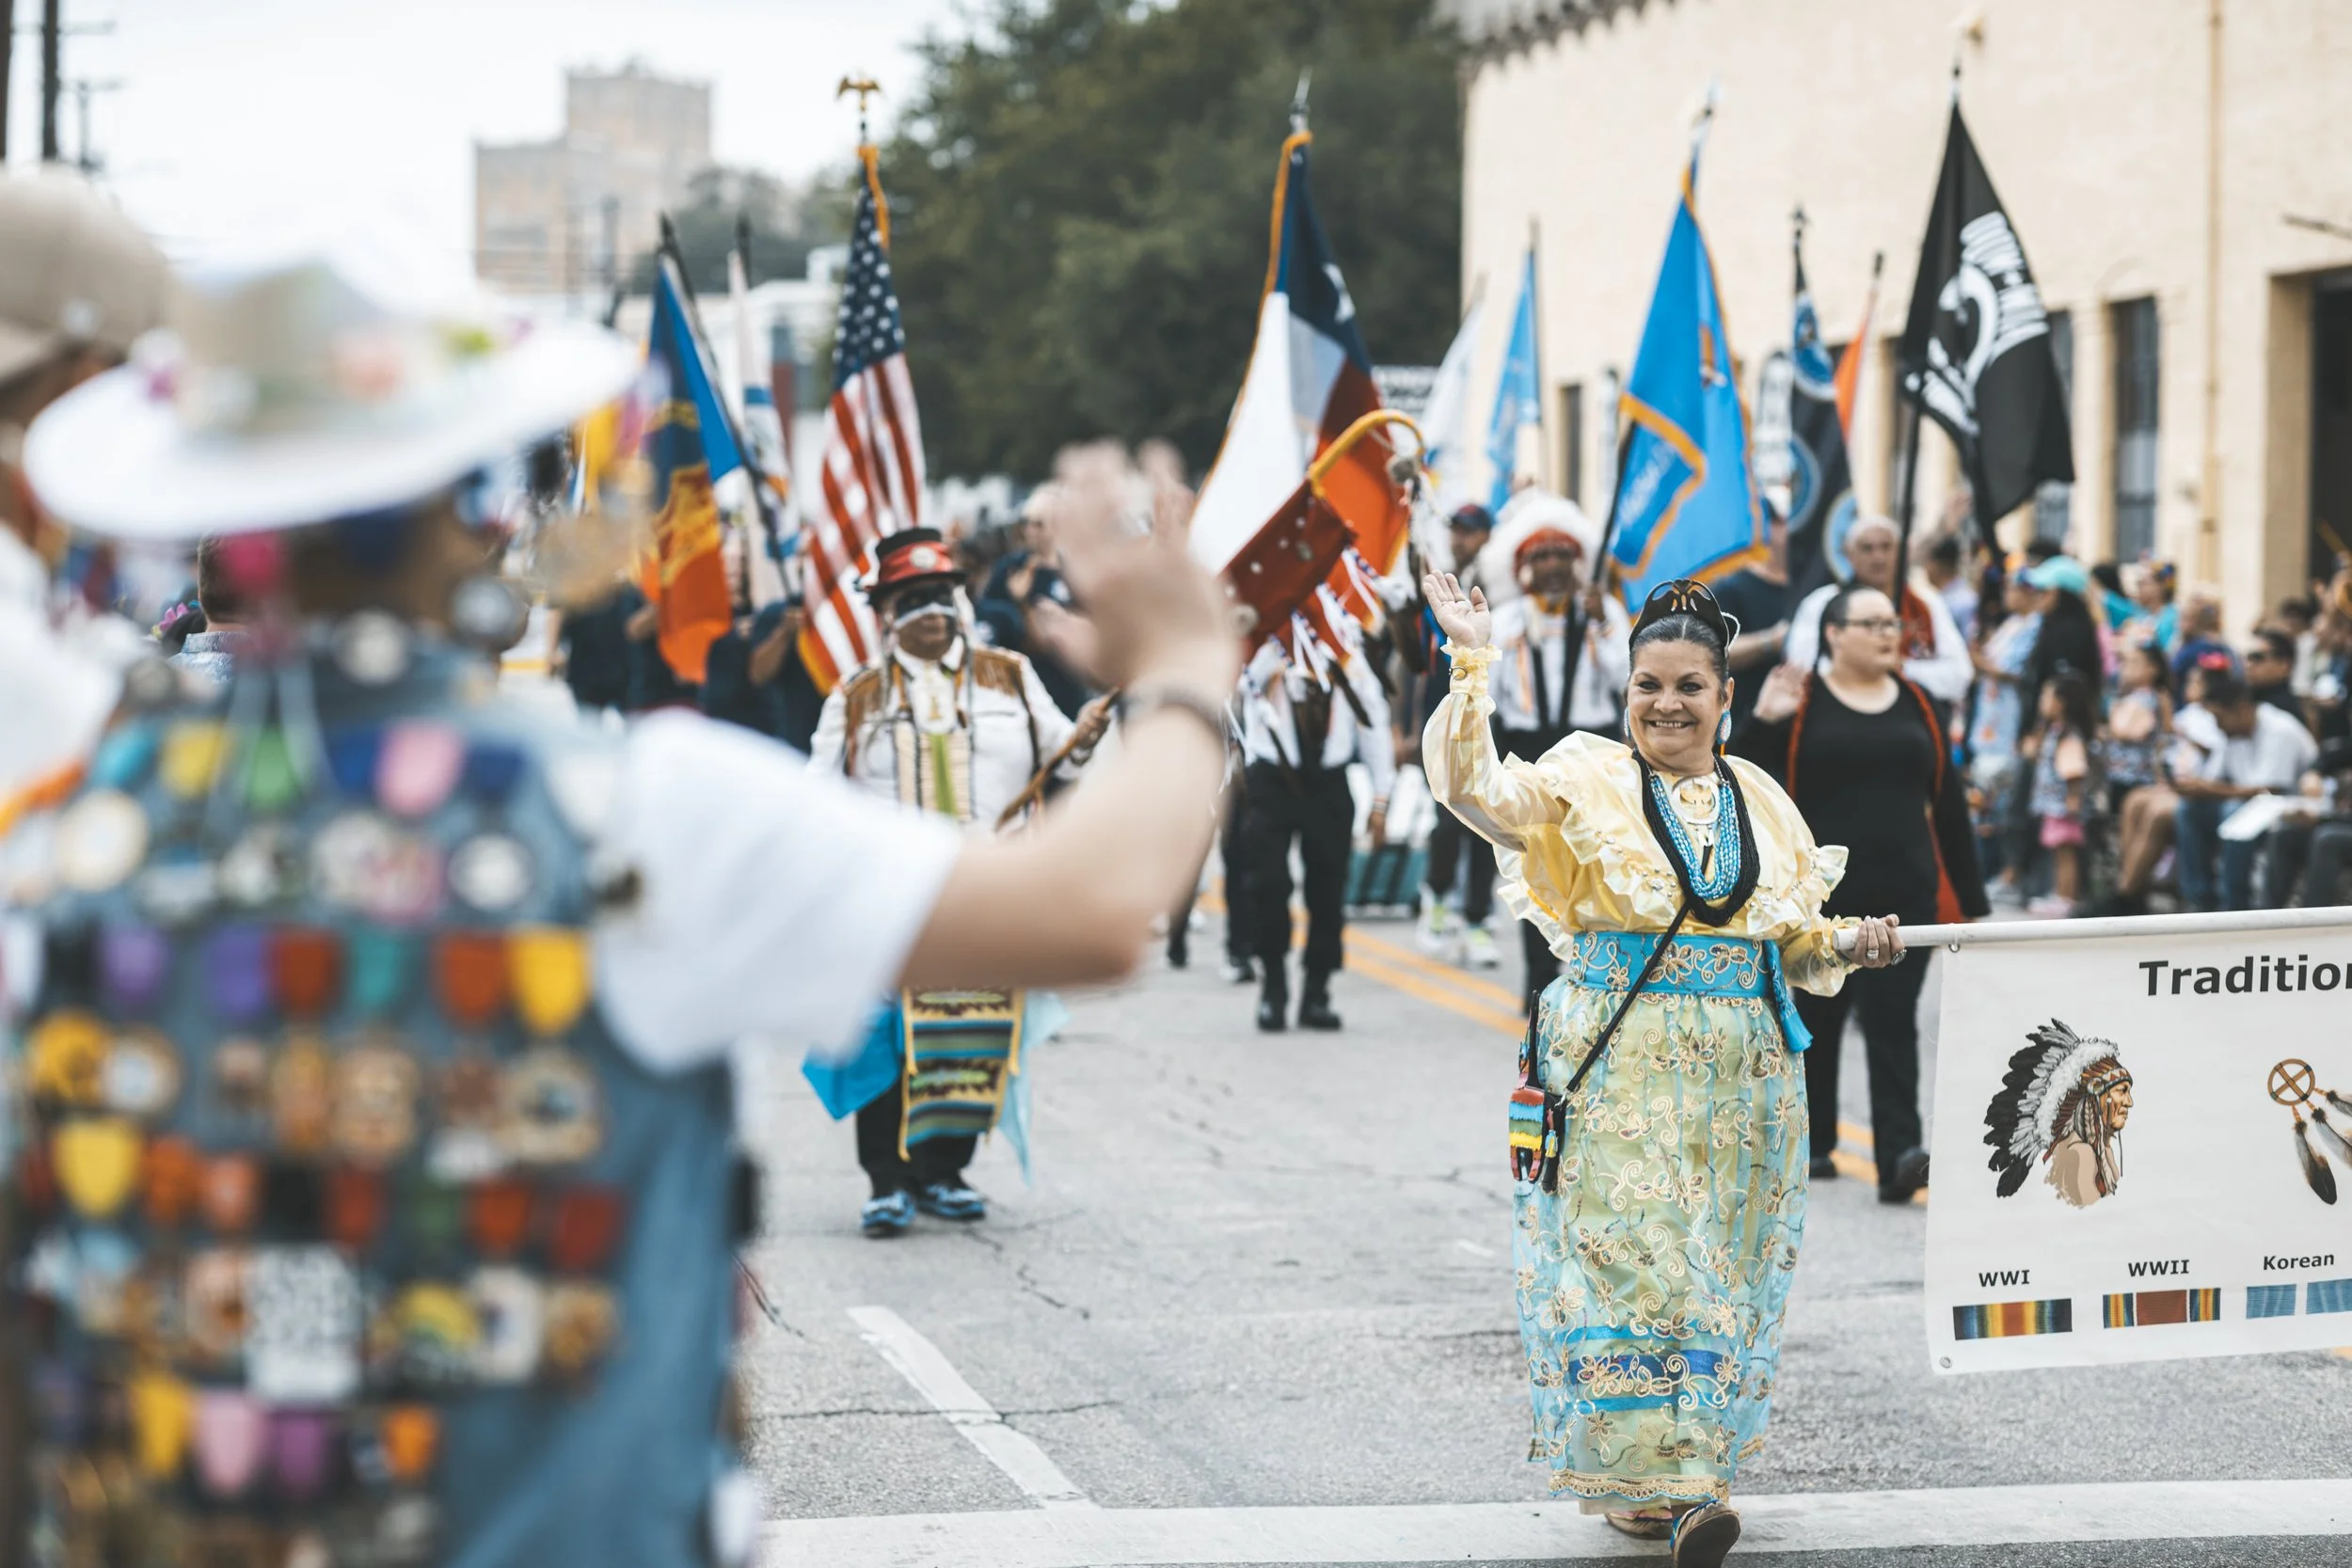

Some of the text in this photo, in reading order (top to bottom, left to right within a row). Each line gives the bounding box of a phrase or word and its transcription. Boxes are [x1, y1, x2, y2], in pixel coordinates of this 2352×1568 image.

[2138, 954, 2352, 997] Traditio
[2128, 1259, 2190, 1277] WWII
[2264, 1254, 2335, 1271] Korean
[1979, 1269, 2030, 1288] WWI
